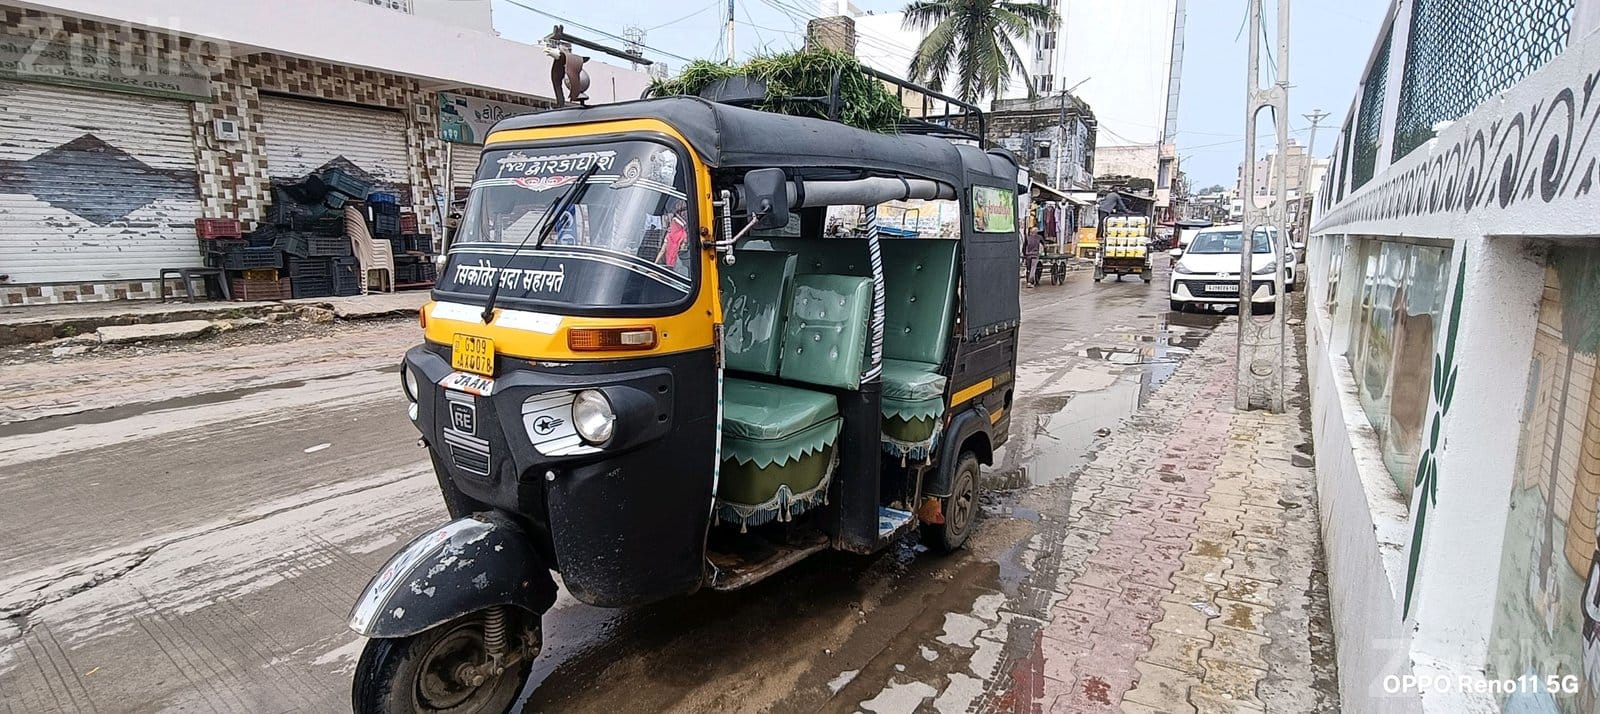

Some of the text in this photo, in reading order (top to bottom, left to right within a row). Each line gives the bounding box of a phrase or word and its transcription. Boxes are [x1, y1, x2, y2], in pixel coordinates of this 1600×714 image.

[506, 161, 525, 172] જય
[523, 264, 564, 293] सहायते
[465, 337, 486, 354] GJ09
[459, 353, 491, 373] AX0078
[454, 411, 472, 429] RE
